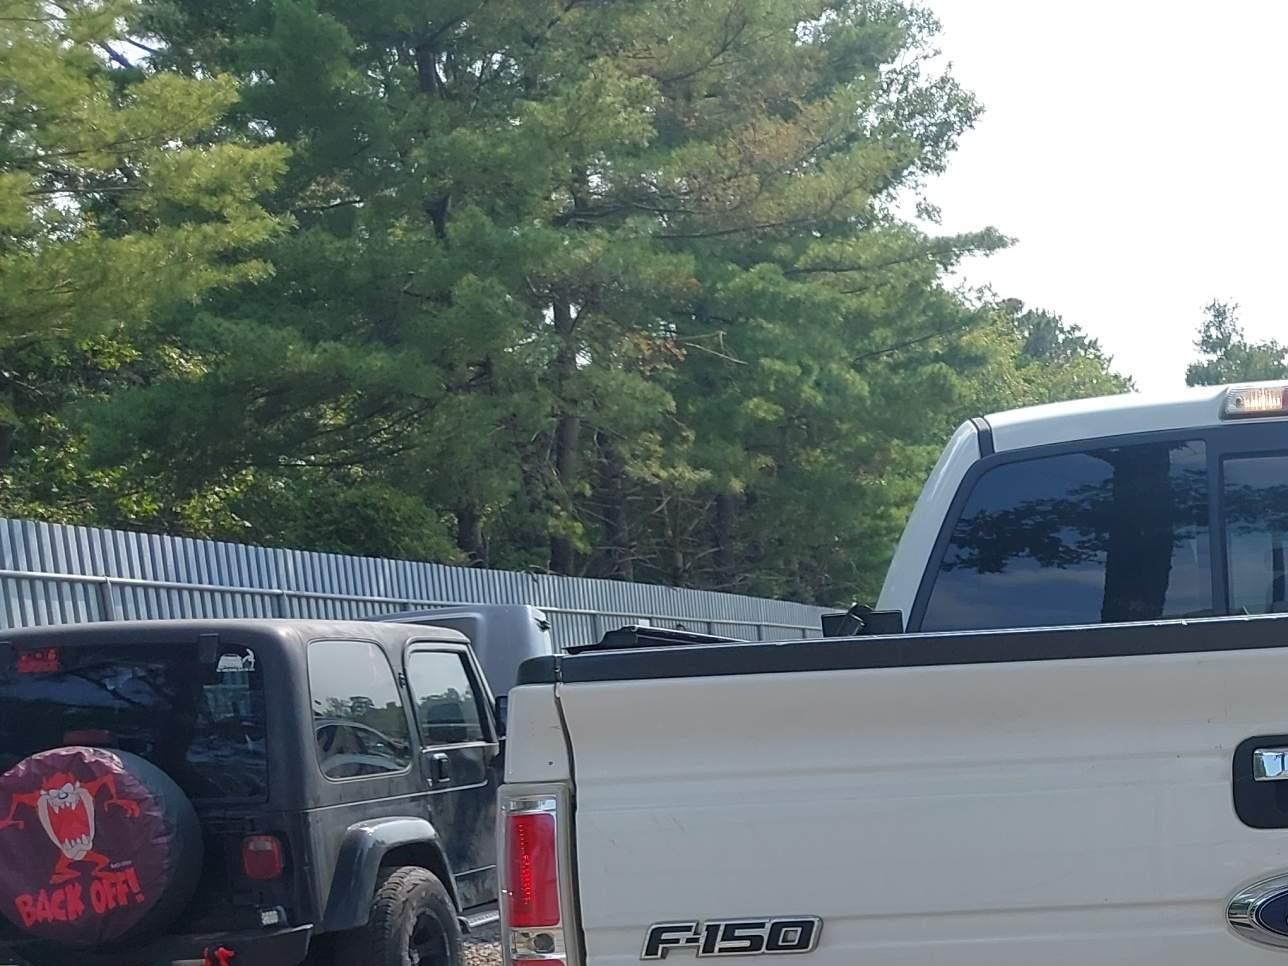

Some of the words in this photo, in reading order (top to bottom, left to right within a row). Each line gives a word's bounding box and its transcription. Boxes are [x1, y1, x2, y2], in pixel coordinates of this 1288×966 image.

[15, 882, 86, 928] BACK
[90, 867, 145, 914] OFF!
[640, 916, 824, 961] F-150
